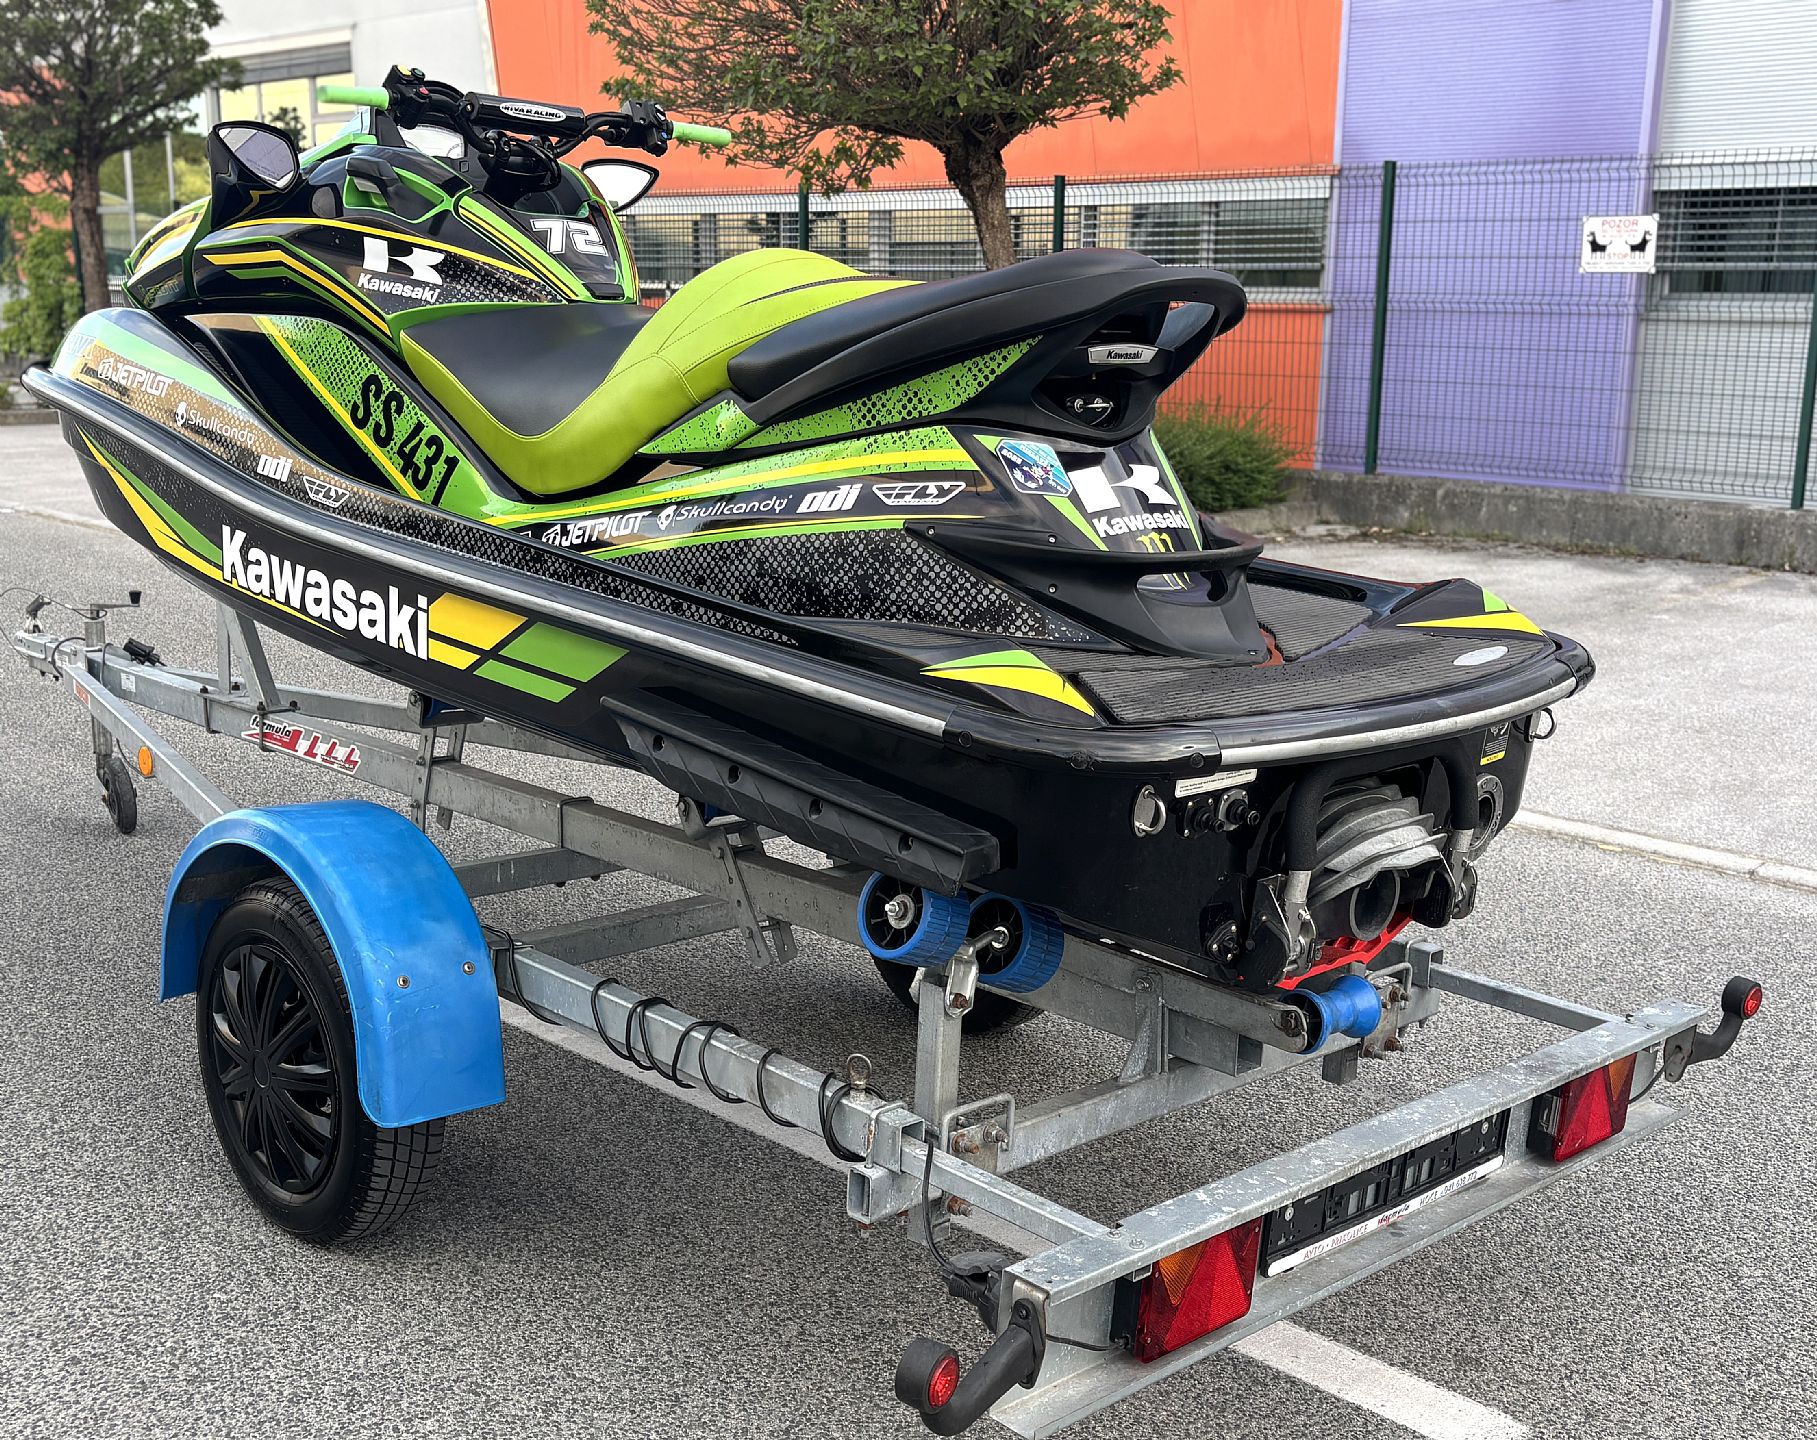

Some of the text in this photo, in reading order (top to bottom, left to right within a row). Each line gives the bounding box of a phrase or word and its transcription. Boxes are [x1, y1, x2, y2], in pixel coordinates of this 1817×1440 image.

[530, 219, 608, 257] 72
[1602, 219, 1639, 229] POZOR
[357, 273, 441, 303] Kawasaki
[1106, 350, 1144, 360] Kawasaki
[188, 410, 255, 448] Skullcandy
[350, 374, 460, 507] SS 431
[256, 453, 293, 482] odi
[676, 496, 789, 521] Skullcandy
[796, 484, 864, 514] odi
[562, 511, 652, 547] JETPILOT
[1092, 510, 1190, 538] Kawasaki
[221, 524, 428, 661] Kawasaki
